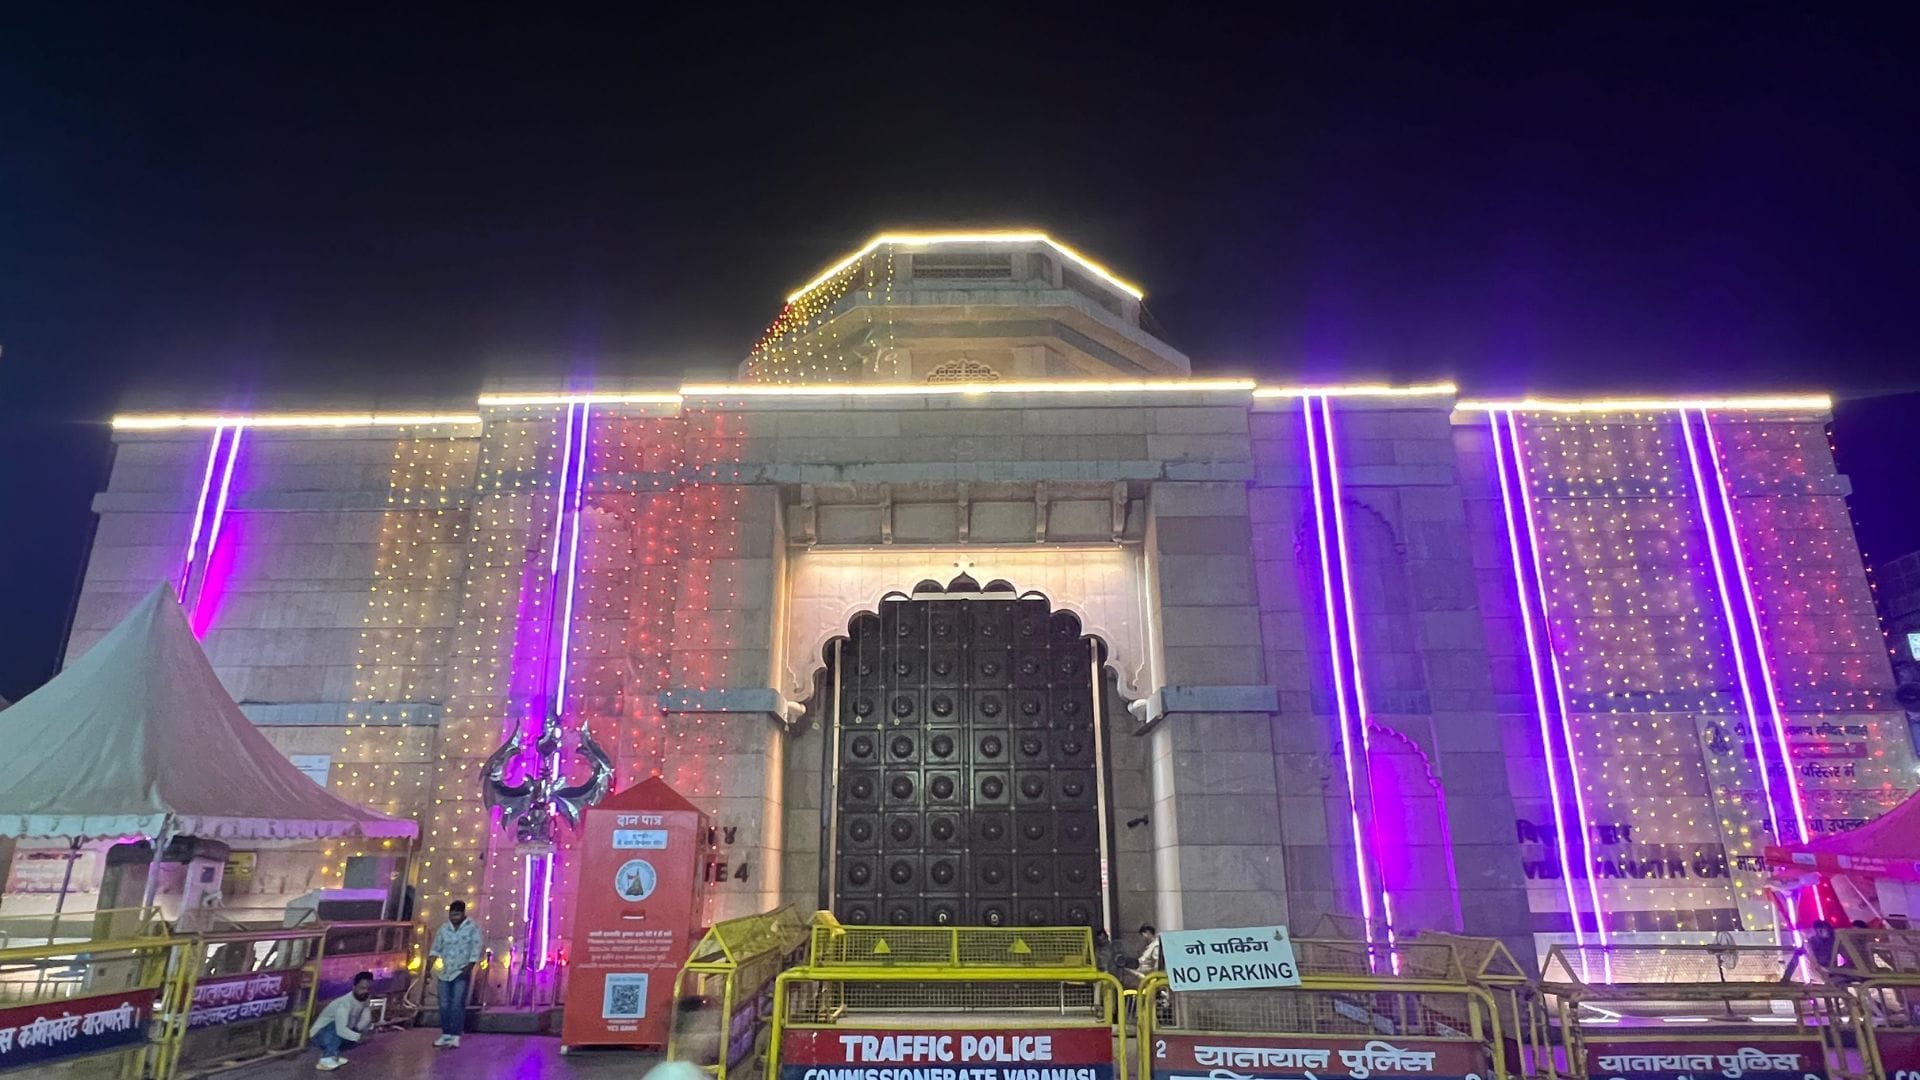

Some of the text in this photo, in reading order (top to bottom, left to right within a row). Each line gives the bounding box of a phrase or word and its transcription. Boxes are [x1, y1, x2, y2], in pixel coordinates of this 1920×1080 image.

[616, 814, 664, 827] दान पात्र
[734, 862, 749, 883] 4
[1184, 936, 1269, 955] नो पार्किंग
[1172, 962, 1294, 984] NO PARKING
[839, 1035, 1053, 1063] TRAFFIC POLICE
[1193, 1040, 1436, 1079] यातायात पुलिस
[1597, 1047, 1802, 1077] यातायात पुलिस
